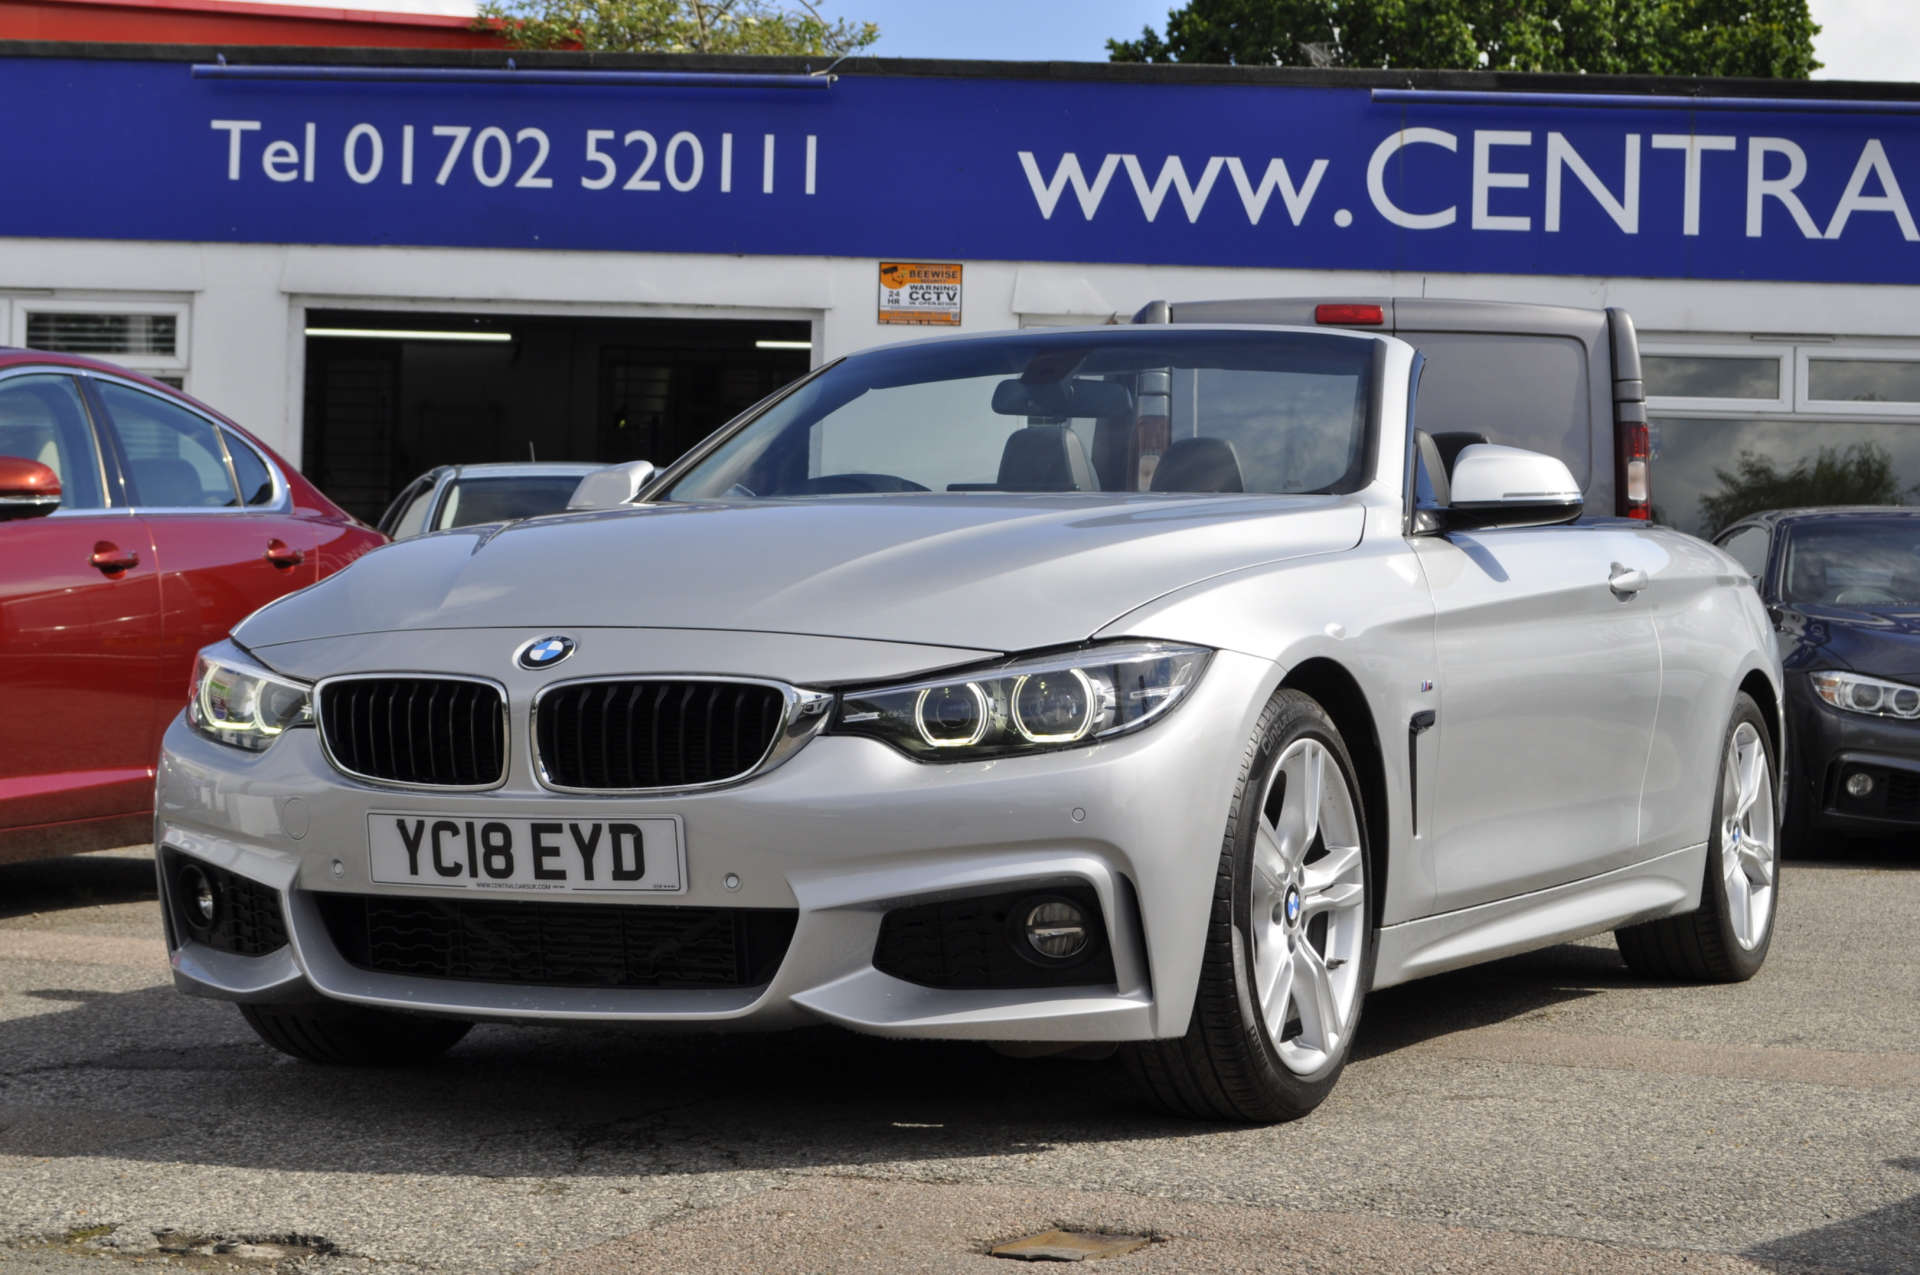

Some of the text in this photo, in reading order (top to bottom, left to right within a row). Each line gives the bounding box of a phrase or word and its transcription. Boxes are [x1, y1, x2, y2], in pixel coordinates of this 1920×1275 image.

[211, 119, 817, 195] Tel 01702 520111
[909, 271, 958, 279] BEEWISE
[909, 291, 957, 302] CCTV
[395, 818, 646, 882] YC18 EYD
